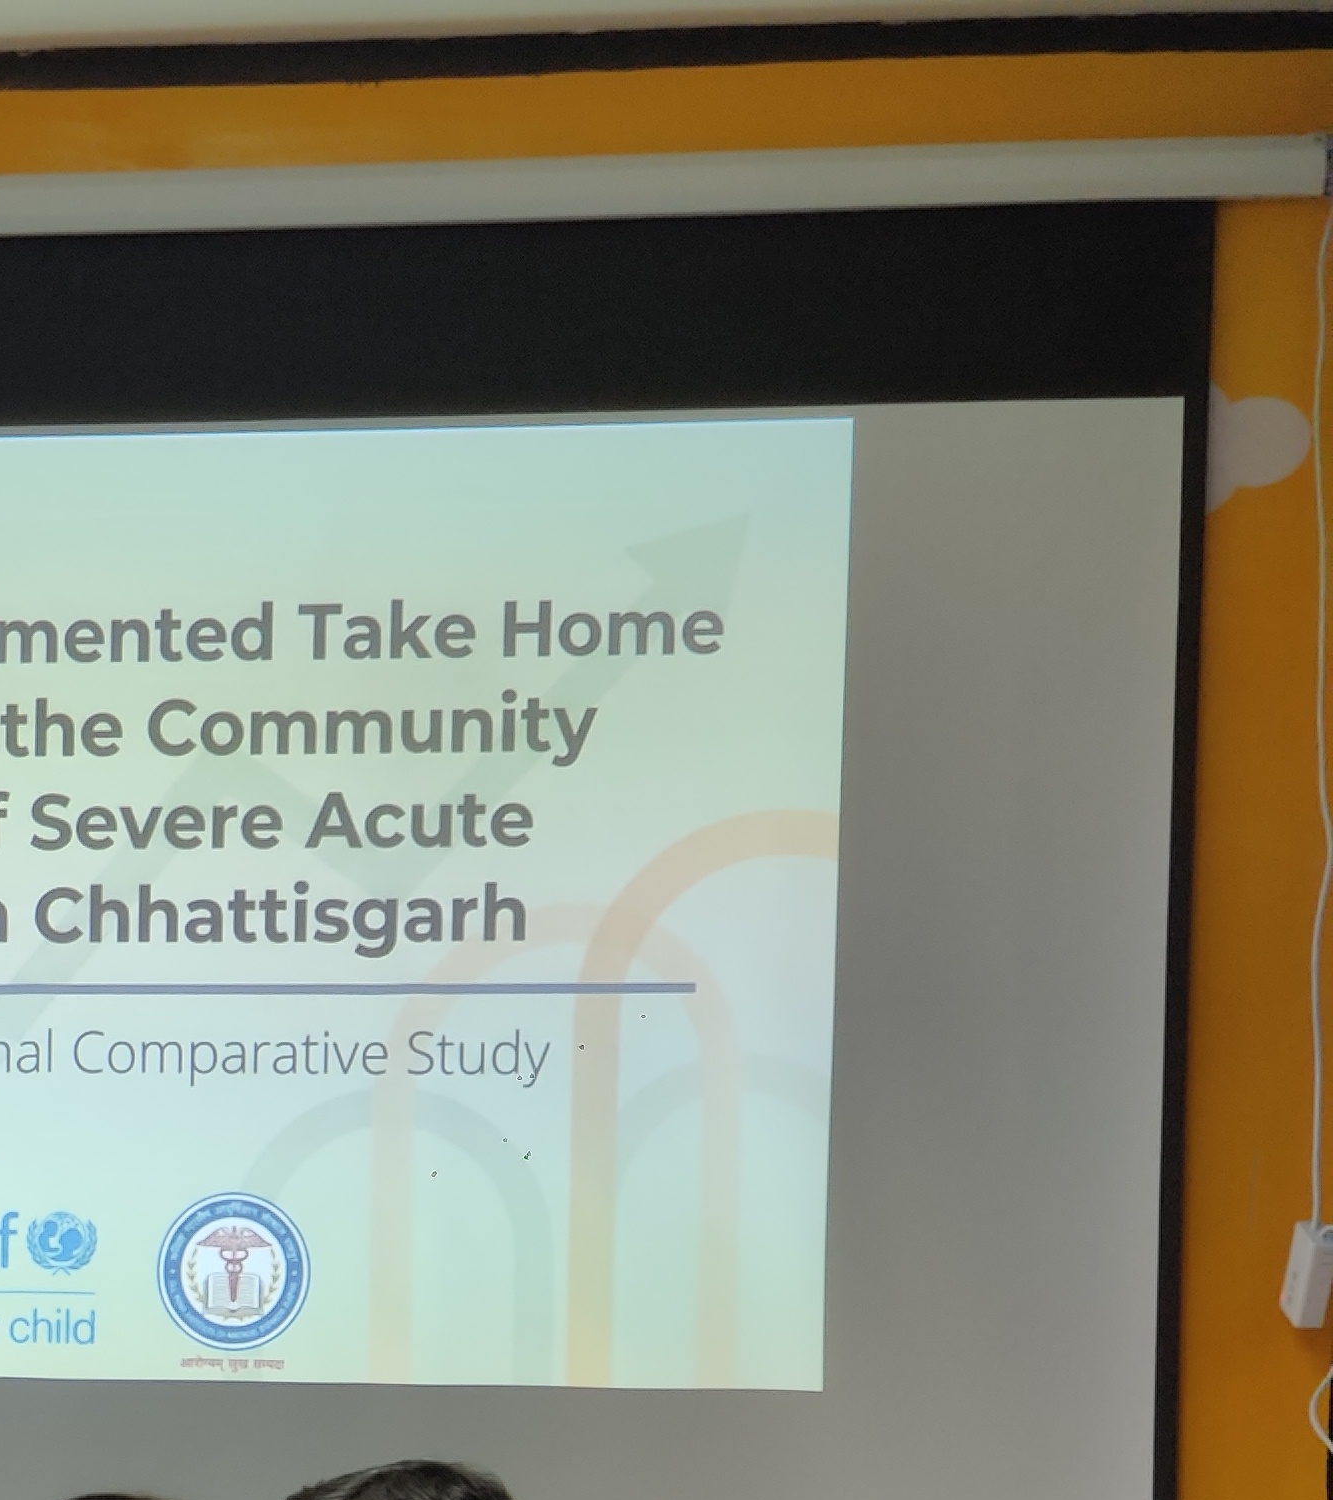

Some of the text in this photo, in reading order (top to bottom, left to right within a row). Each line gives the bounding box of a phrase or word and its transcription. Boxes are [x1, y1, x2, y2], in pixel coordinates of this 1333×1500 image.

[298, 600, 476, 659] Take
[503, 600, 724, 657] Home
[0, 697, 123, 757] the
[147, 690, 598, 766] Community
[30, 793, 283, 850] Severe
[304, 791, 534, 848] Acute
[34, 880, 526, 958] Chhattisgarh
[73, 1029, 389, 1088] Comparative
[406, 1028, 551, 1089] Study
[8, 1307, 96, 1346] child
